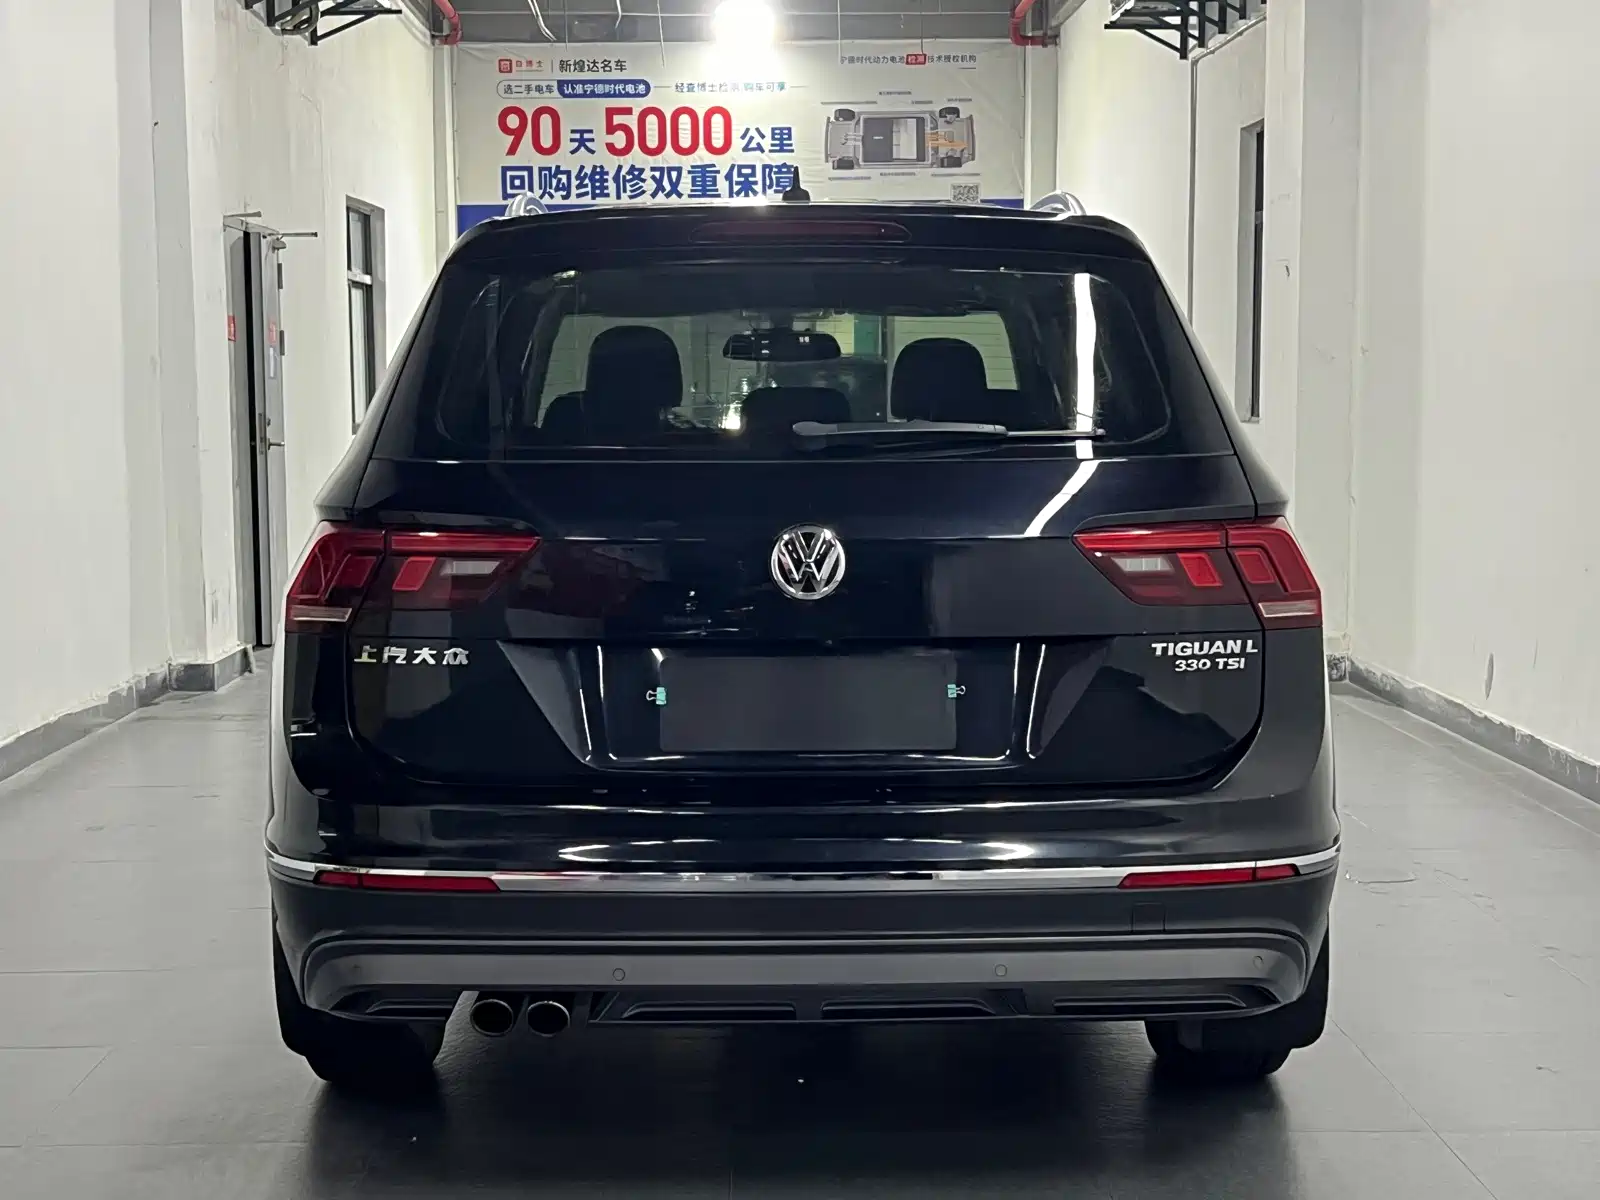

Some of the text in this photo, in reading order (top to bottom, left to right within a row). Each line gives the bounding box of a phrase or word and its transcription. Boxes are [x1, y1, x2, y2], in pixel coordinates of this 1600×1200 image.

[559, 59, 627, 73] 新煌达名车
[503, 83, 646, 95] 选二手电车 认准宁德时代电池
[498, 105, 795, 157] 90 天 5000 公里
[501, 162, 796, 200] 回购维修双重保障
[354, 645, 469, 665] 上汽大众
[1151, 639, 1258, 656] TIGUAN L
[1175, 657, 1245, 672] 330 TSI
